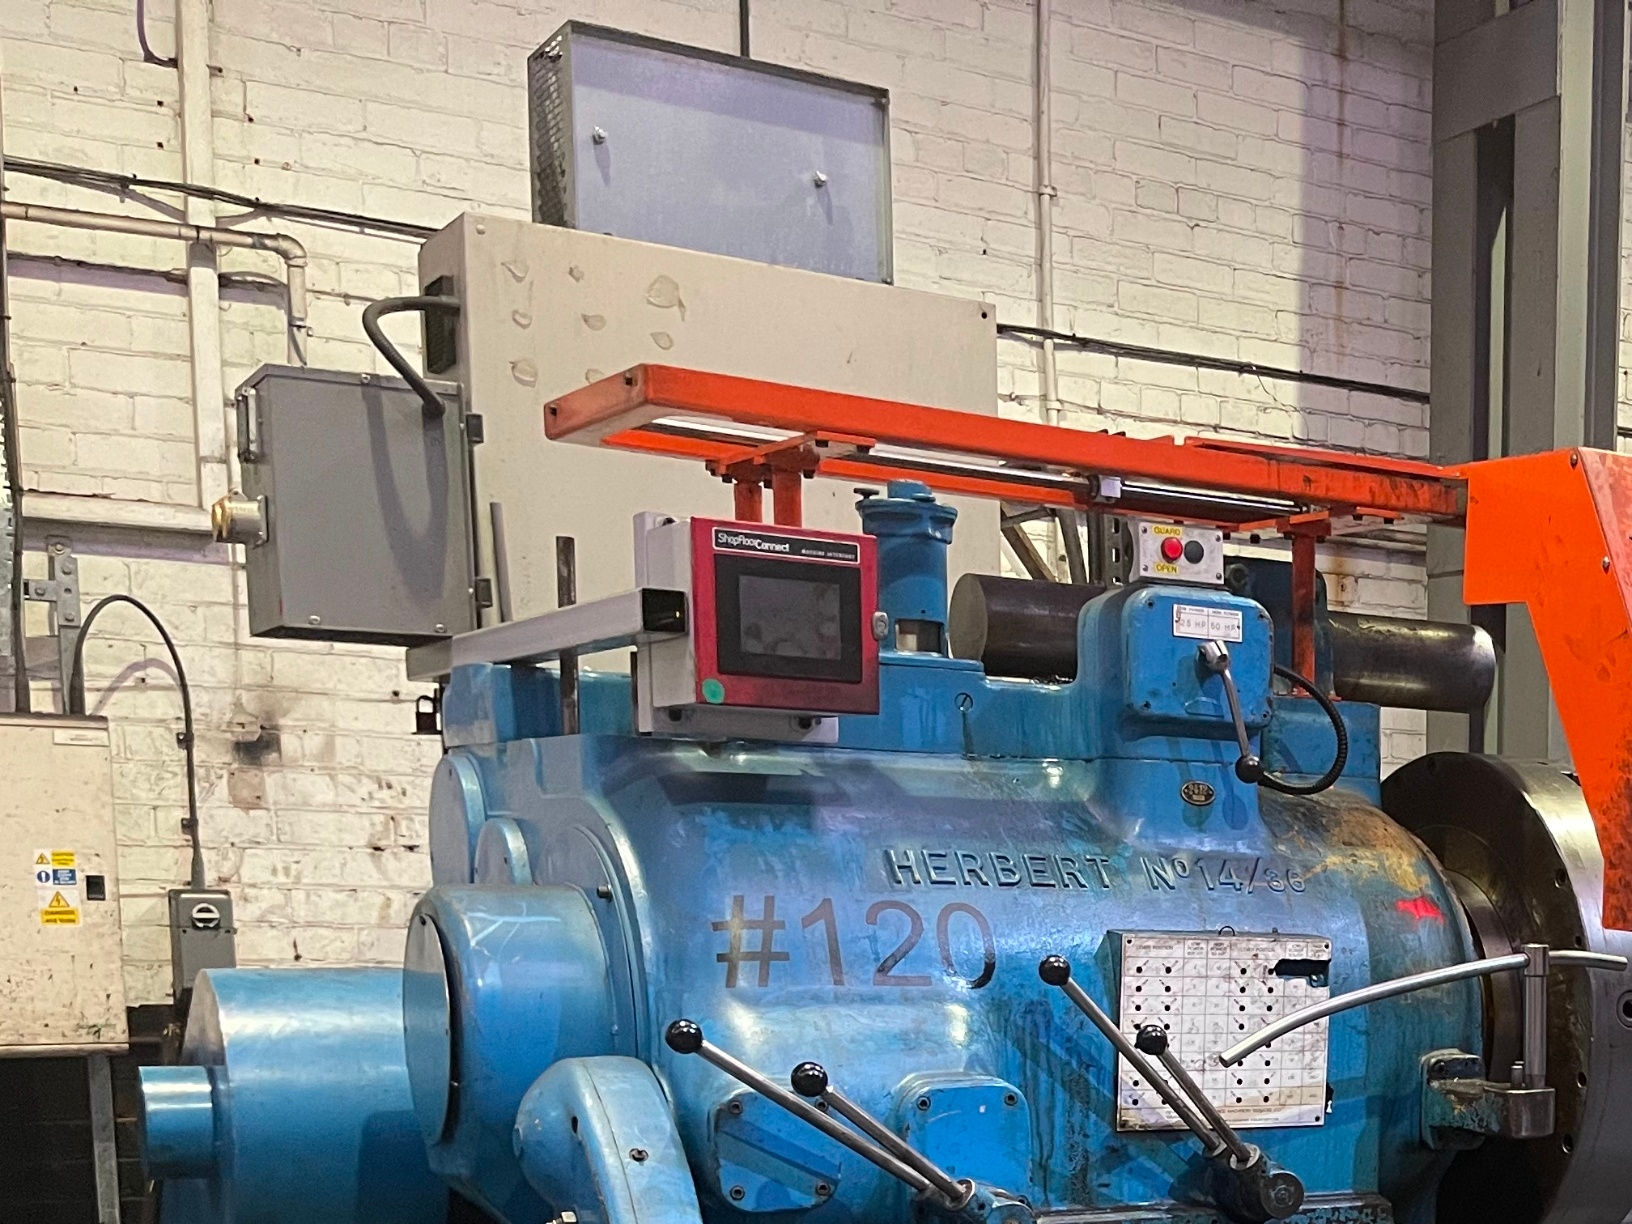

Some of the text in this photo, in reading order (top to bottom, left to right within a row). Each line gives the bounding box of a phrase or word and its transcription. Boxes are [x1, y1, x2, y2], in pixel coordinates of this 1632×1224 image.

[1153, 526, 1181, 536] GUARD
[1155, 564, 1177, 573] OPEN
[885, 849, 1110, 890] HERBERT
[711, 894, 997, 990] #120
